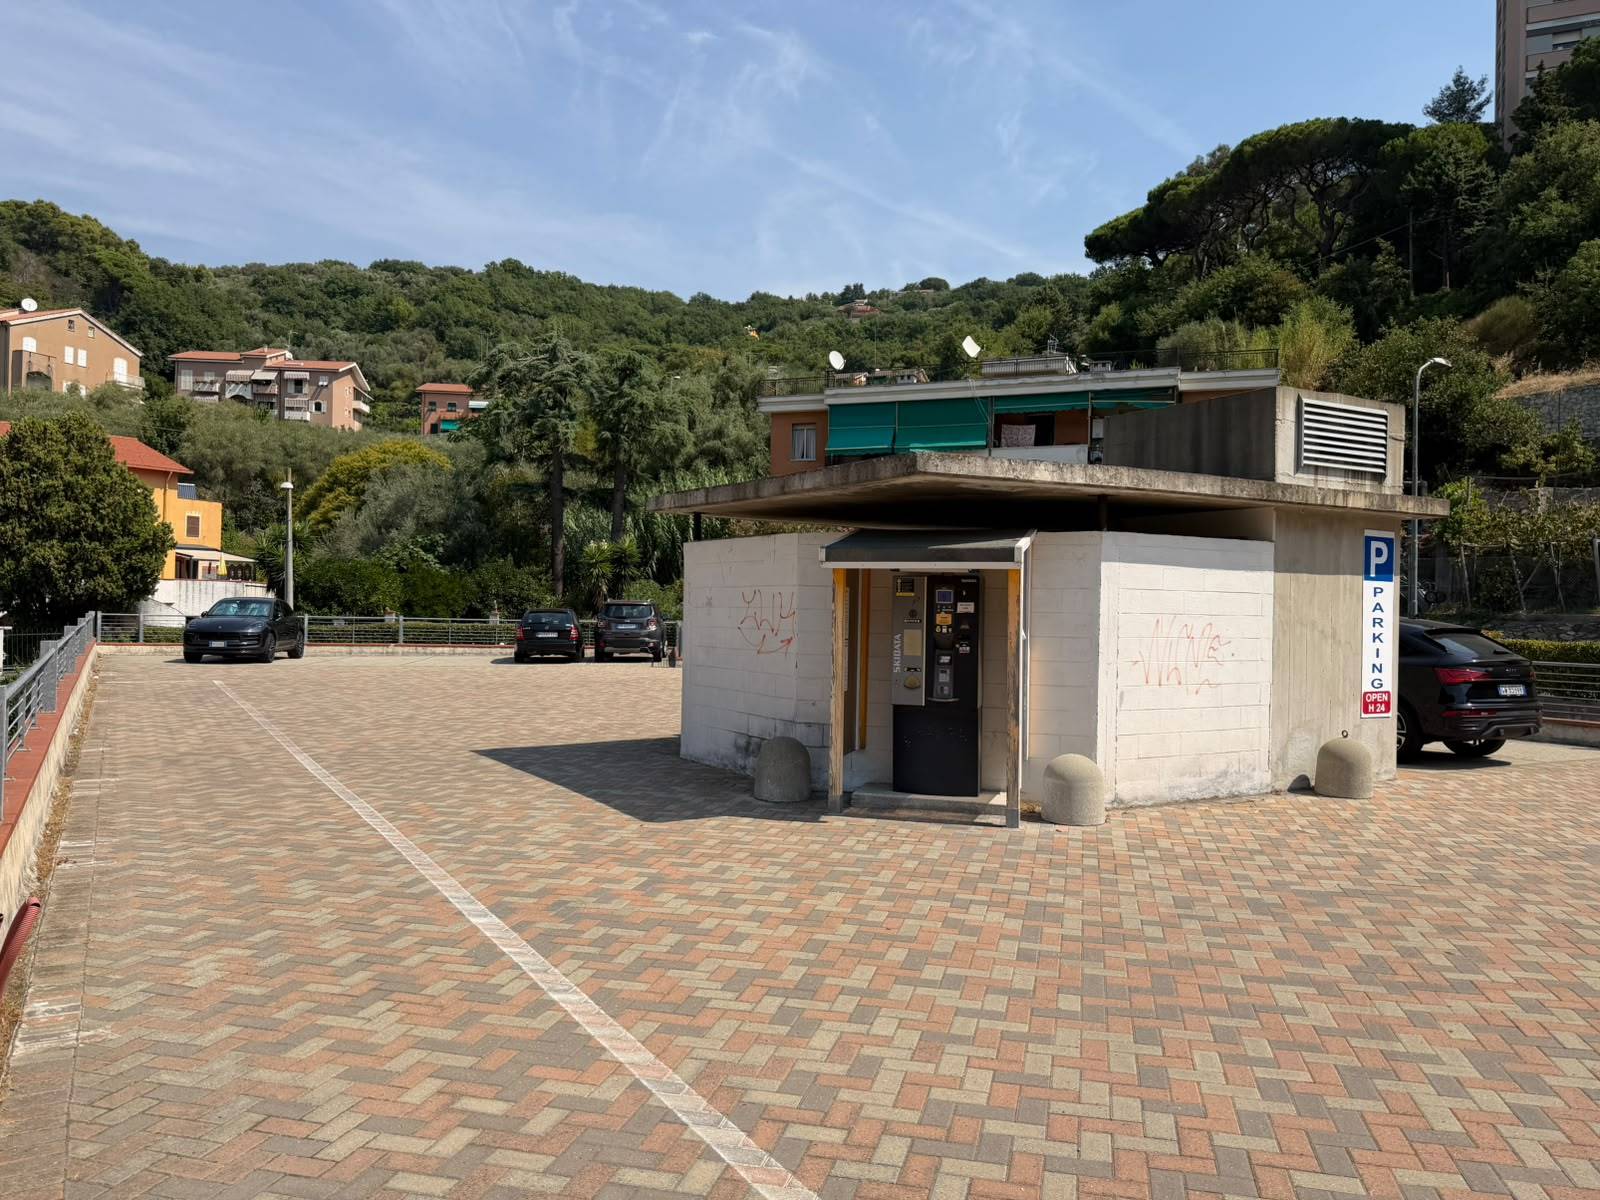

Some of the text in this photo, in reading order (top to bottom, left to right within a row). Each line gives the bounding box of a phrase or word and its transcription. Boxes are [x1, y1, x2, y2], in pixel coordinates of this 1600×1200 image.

[1370, 541, 1388, 577] P
[893, 633, 902, 673] SKIDATA
[1371, 587, 1384, 689] PARKING
[1365, 692, 1388, 702] OPEN
[1368, 702, 1385, 712] H 24
